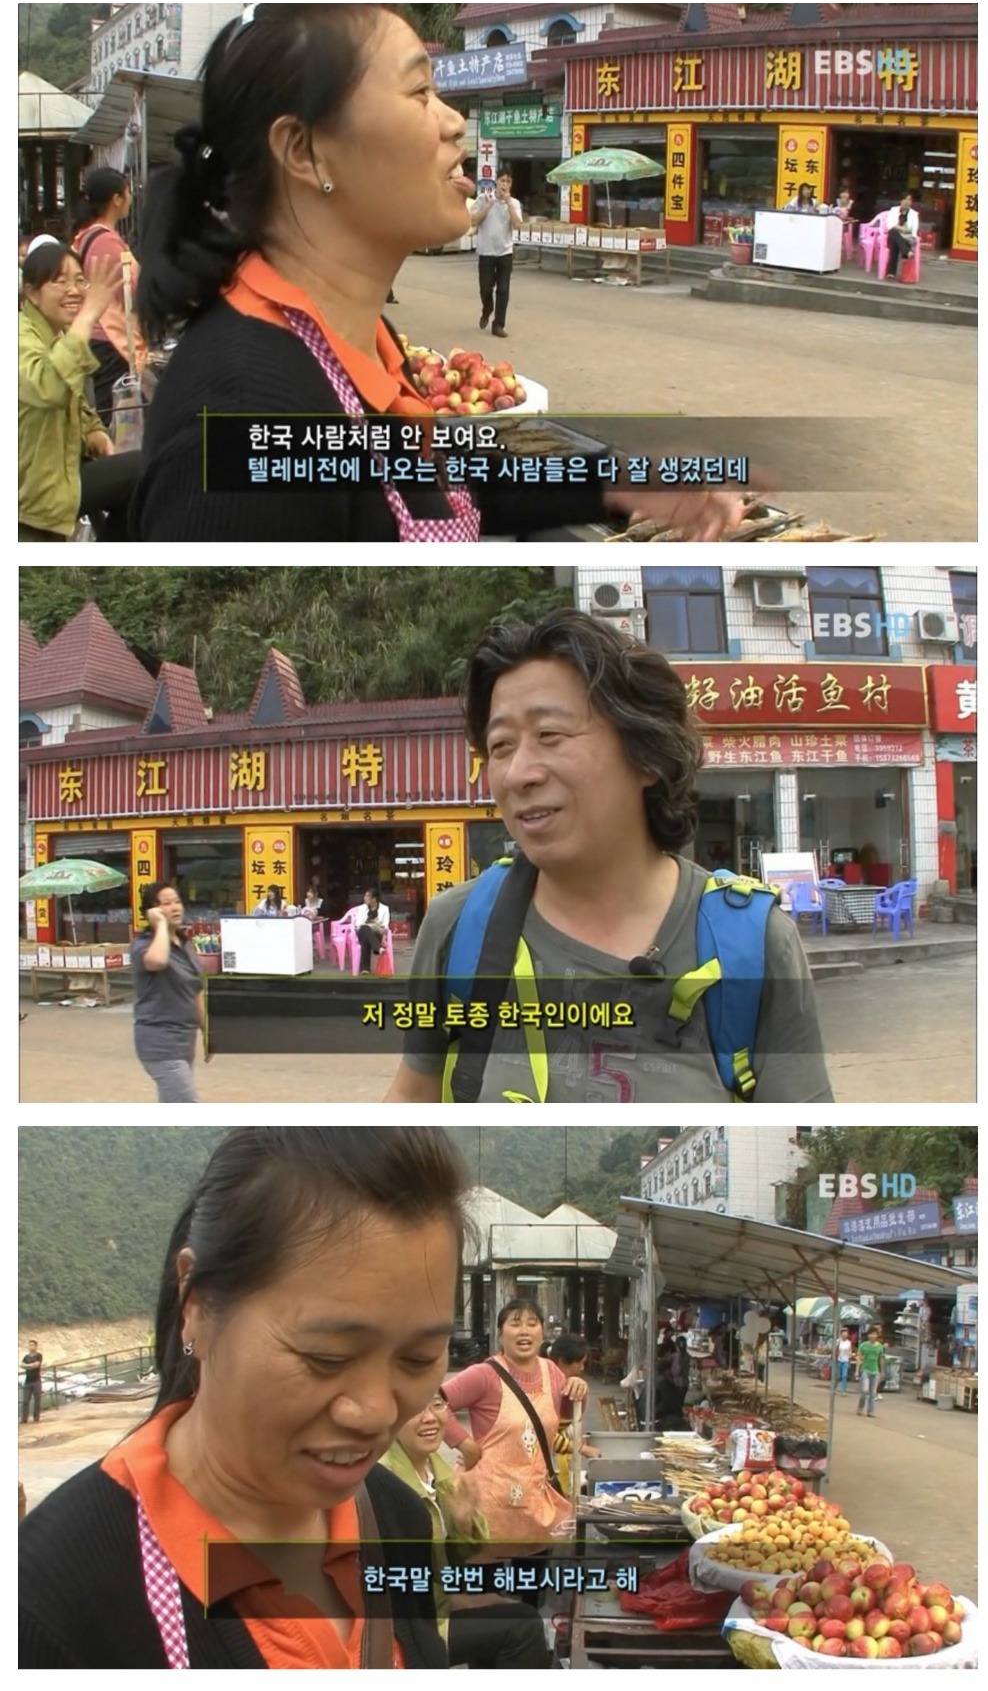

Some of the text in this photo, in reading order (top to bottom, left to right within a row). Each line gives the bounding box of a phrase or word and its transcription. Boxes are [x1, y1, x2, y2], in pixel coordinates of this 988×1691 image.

[481, 143, 493, 178] 干鱼
[784, 158, 798, 197] 坛子
[671, 152, 685, 211] 四件宝
[708, 749, 849, 764] 野生东江鱼 东江干鱼
[722, 735, 782, 748] 柴火腊肉
[790, 735, 848, 748] 山珍土菜
[252, 859, 266, 899] 坛子
